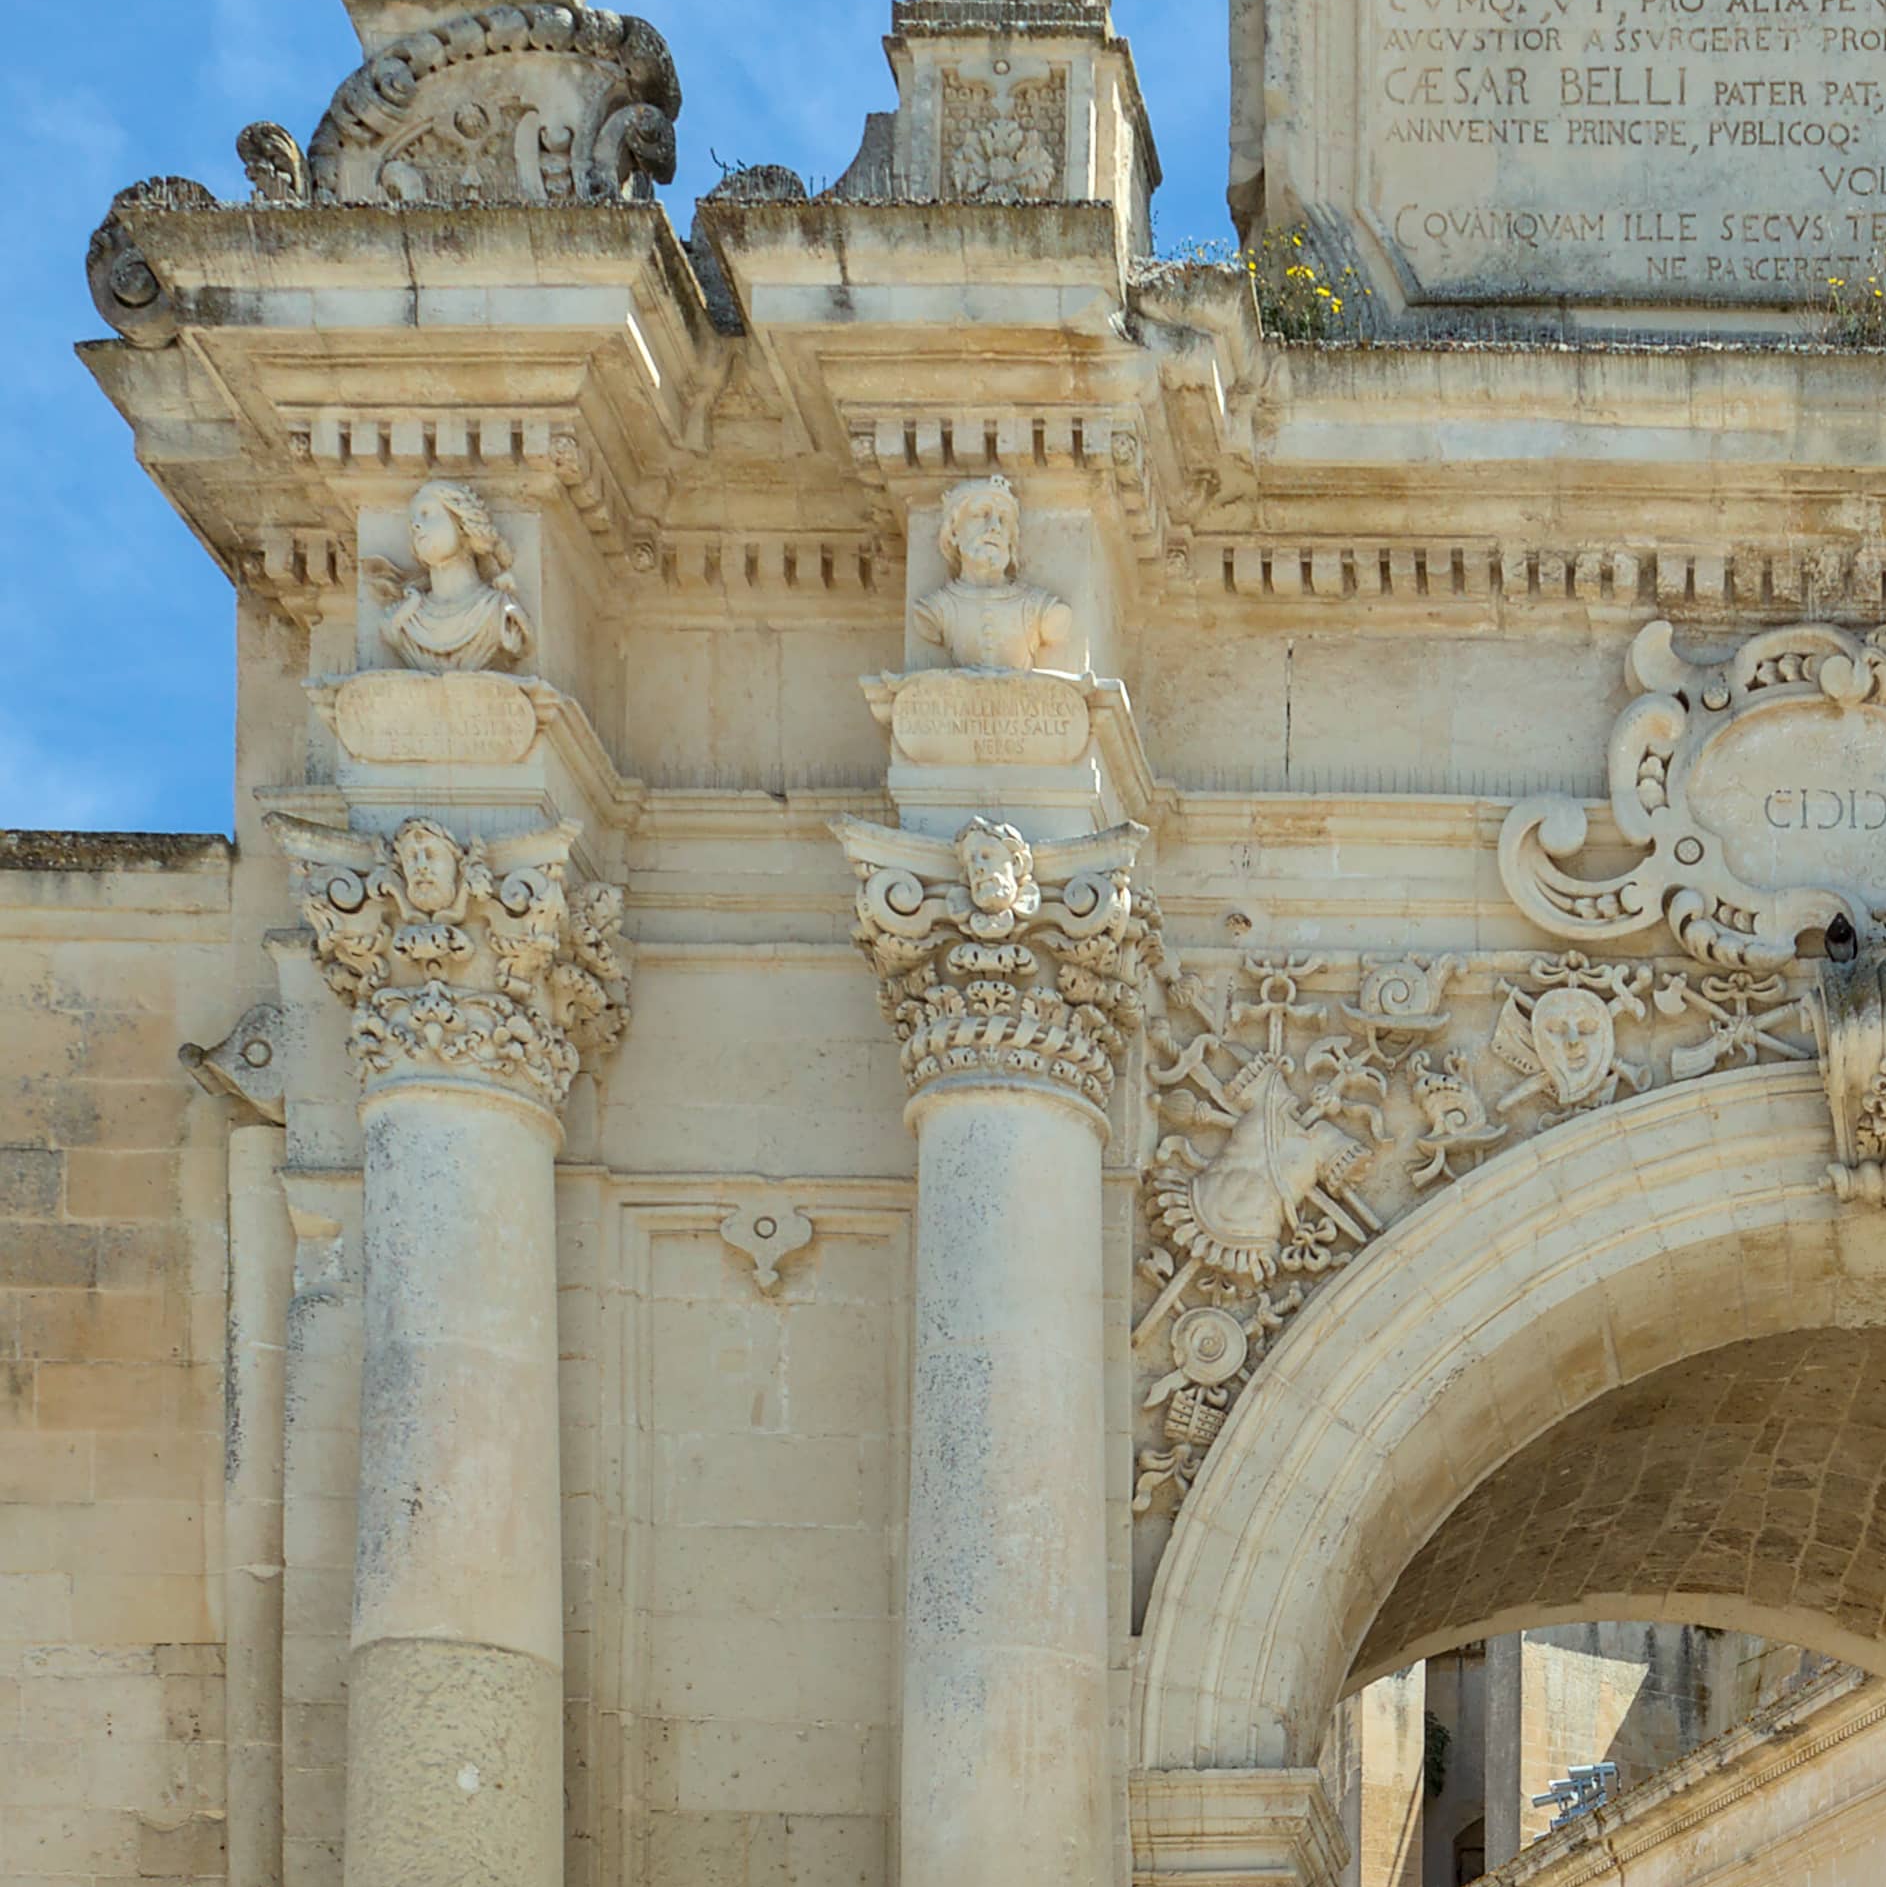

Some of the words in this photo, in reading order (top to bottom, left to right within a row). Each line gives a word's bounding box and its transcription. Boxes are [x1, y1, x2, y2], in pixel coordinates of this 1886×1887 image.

[1383, 27, 1562, 52] AVGVSTIOR
[1583, 25, 1800, 53] ASSVRGERET
[1383, 65, 1531, 108] CÆSAR
[1559, 65, 1688, 107] BELLI
[1713, 80, 1807, 107] PATER
[1385, 118, 1550, 147] ANNVENTE
[1622, 213, 1698, 242] ILLE
[1720, 213, 1824, 242] SECVS
[1646, 256, 1688, 281] NE
